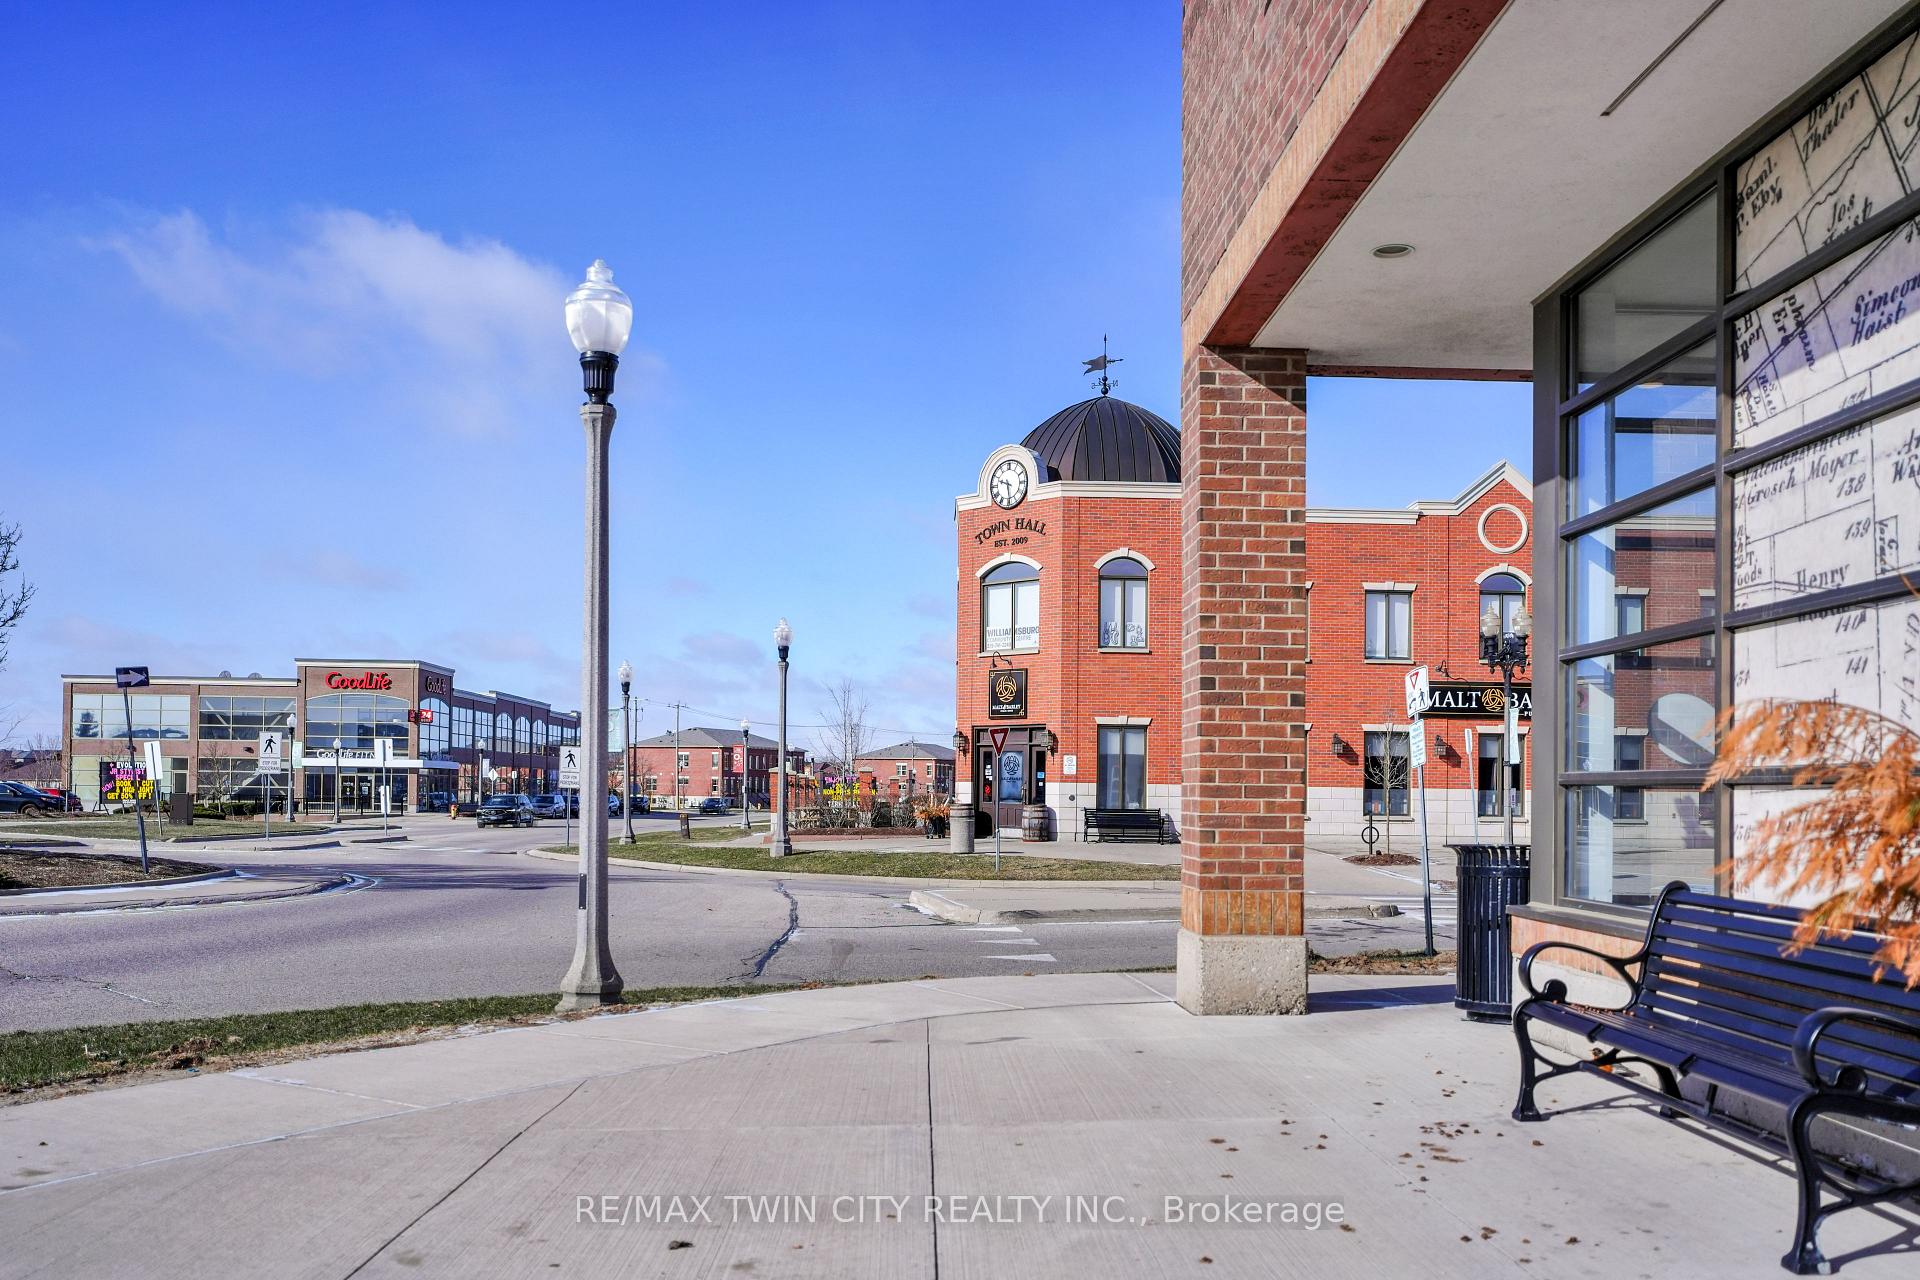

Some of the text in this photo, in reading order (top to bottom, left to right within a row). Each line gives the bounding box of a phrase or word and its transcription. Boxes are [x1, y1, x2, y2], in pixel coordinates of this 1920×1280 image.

[1851, 301, 1907, 347] Haist
[1837, 472, 1866, 498] 138
[975, 517, 1047, 545] TOWN HALL
[1845, 517, 1871, 540] 139
[994, 536, 1028, 547] EST. 2009
[1792, 564, 1850, 593] Henry
[1846, 656, 1868, 675] 141
[325, 671, 393, 690] GoodLife
[1429, 690, 1481, 708] MALT
[421, 711, 432, 719] 24
[316, 748, 354, 759] GooLife
